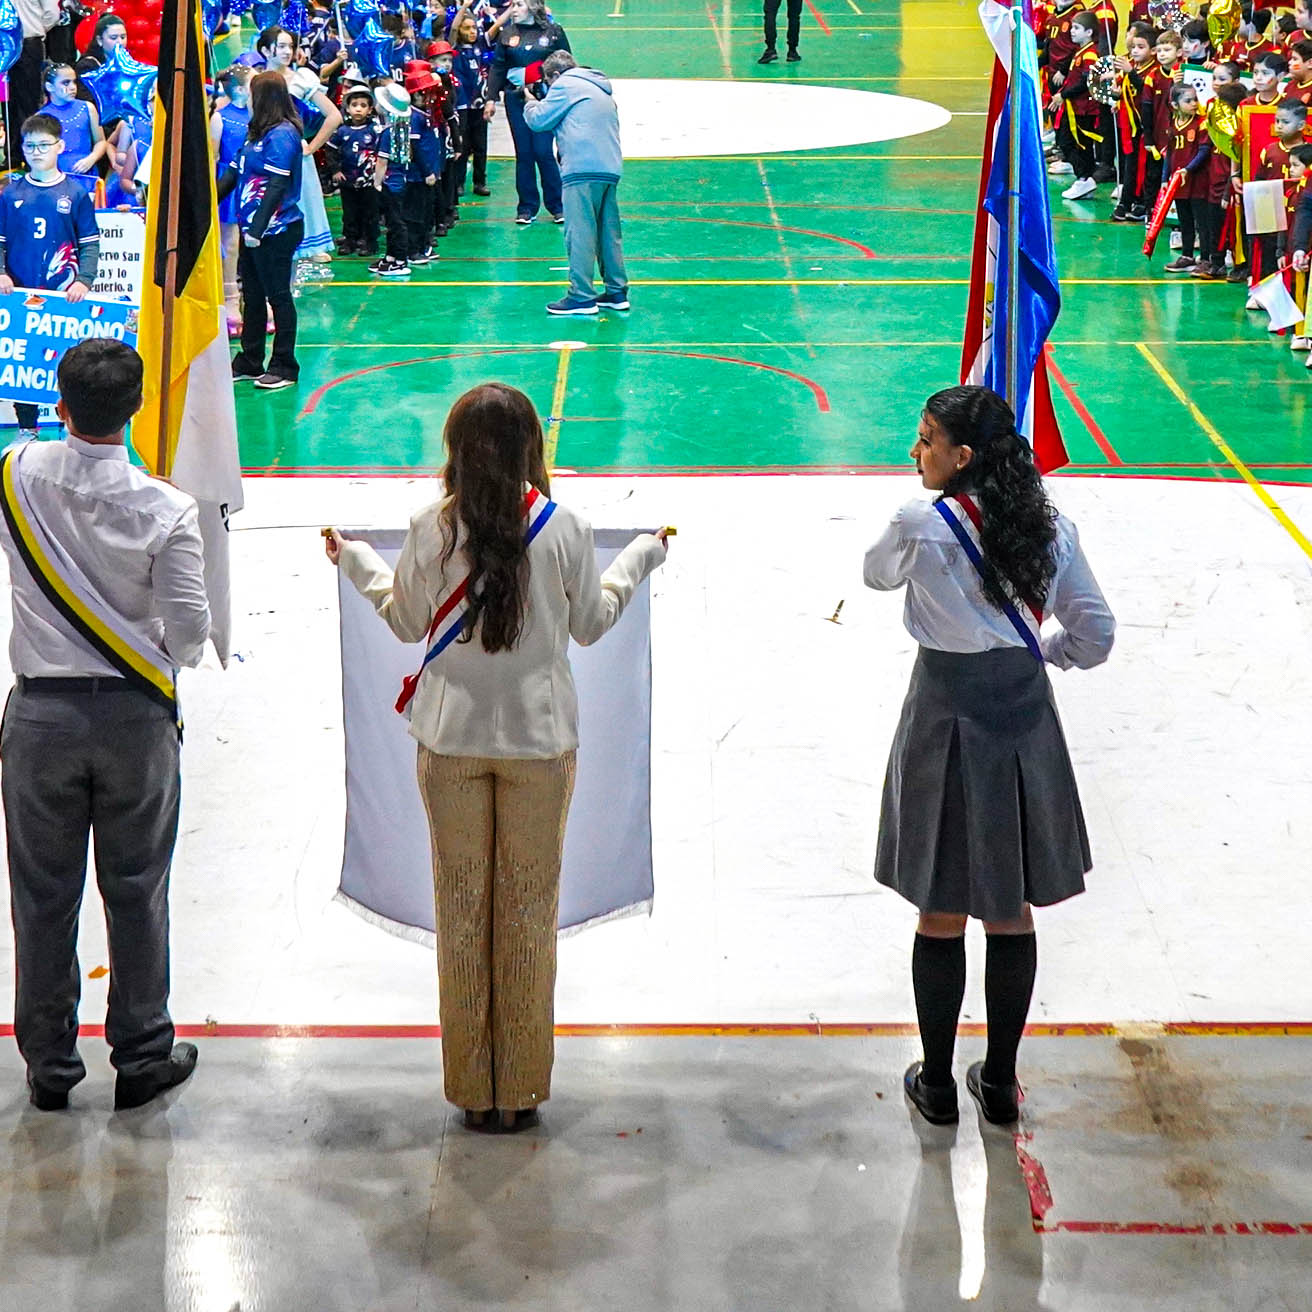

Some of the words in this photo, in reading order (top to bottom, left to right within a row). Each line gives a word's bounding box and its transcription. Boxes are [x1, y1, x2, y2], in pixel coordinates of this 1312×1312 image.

[33, 217, 47, 239] 3
[99, 251, 120, 261] ervo
[122, 250, 140, 262] San
[24, 311, 126, 341] PATRONO
